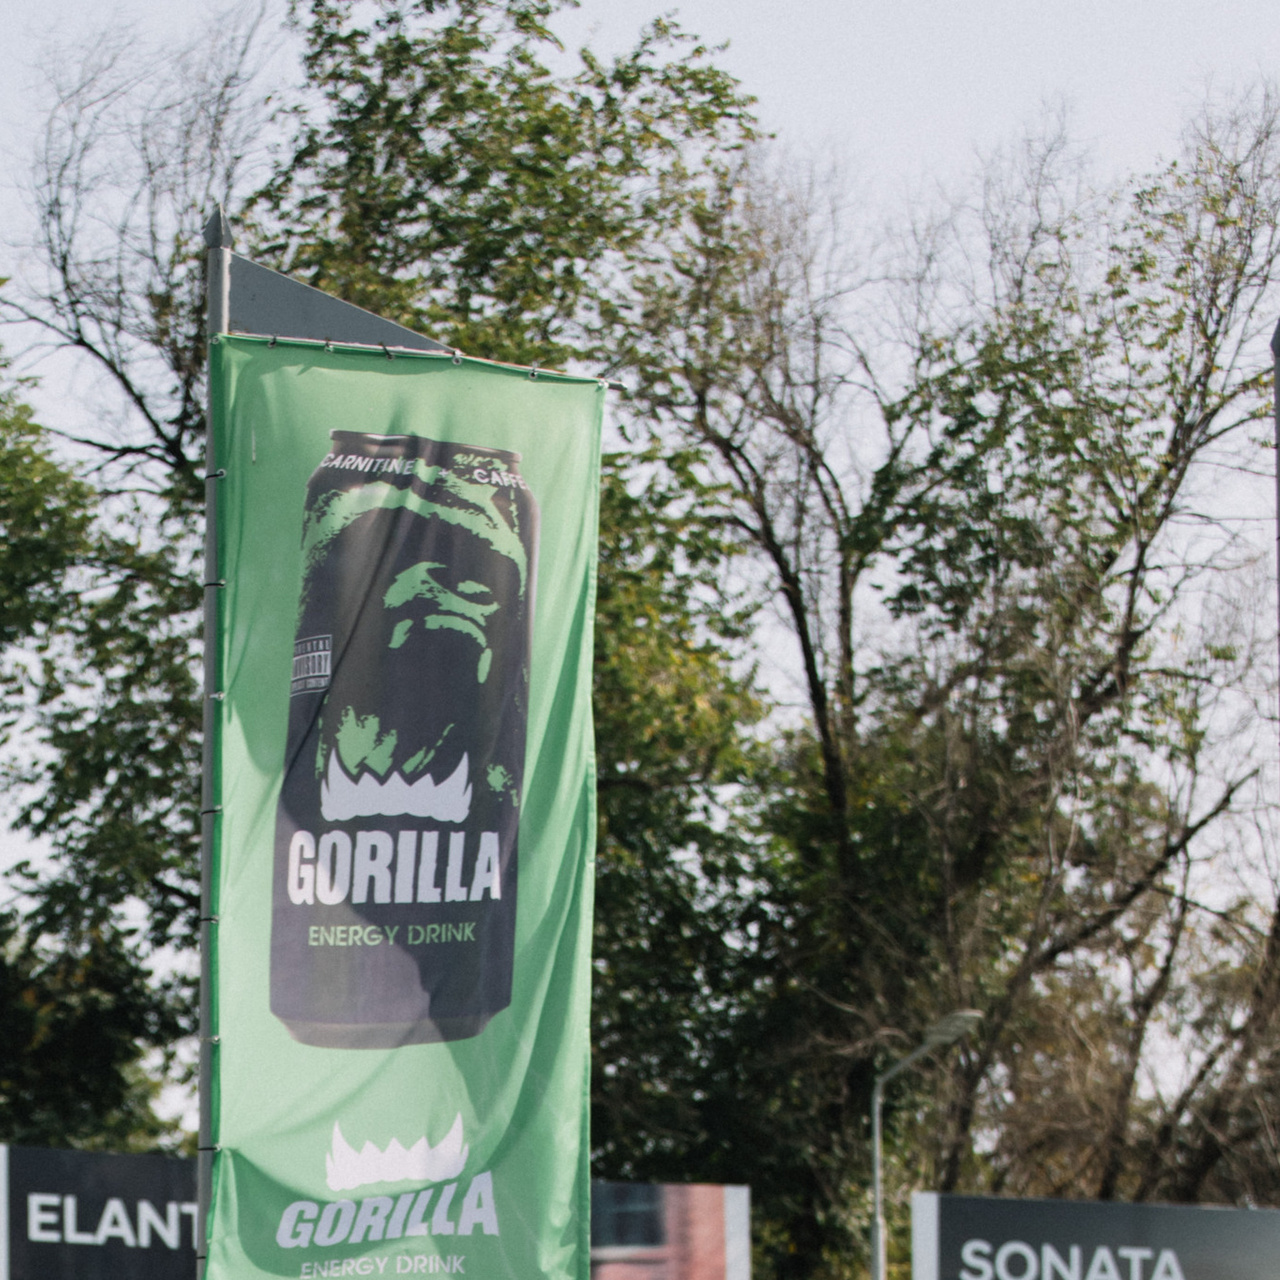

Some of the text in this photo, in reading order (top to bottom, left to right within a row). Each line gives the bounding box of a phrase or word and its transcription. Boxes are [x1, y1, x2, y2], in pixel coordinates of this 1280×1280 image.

[320, 453, 415, 476] CARNITINE
[287, 831, 501, 905] GORILLA
[308, 921, 477, 947] ENERGY DRINK
[275, 1171, 500, 1249] GORILLA
[300, 1254, 466, 1280] ENERGY DRINK
